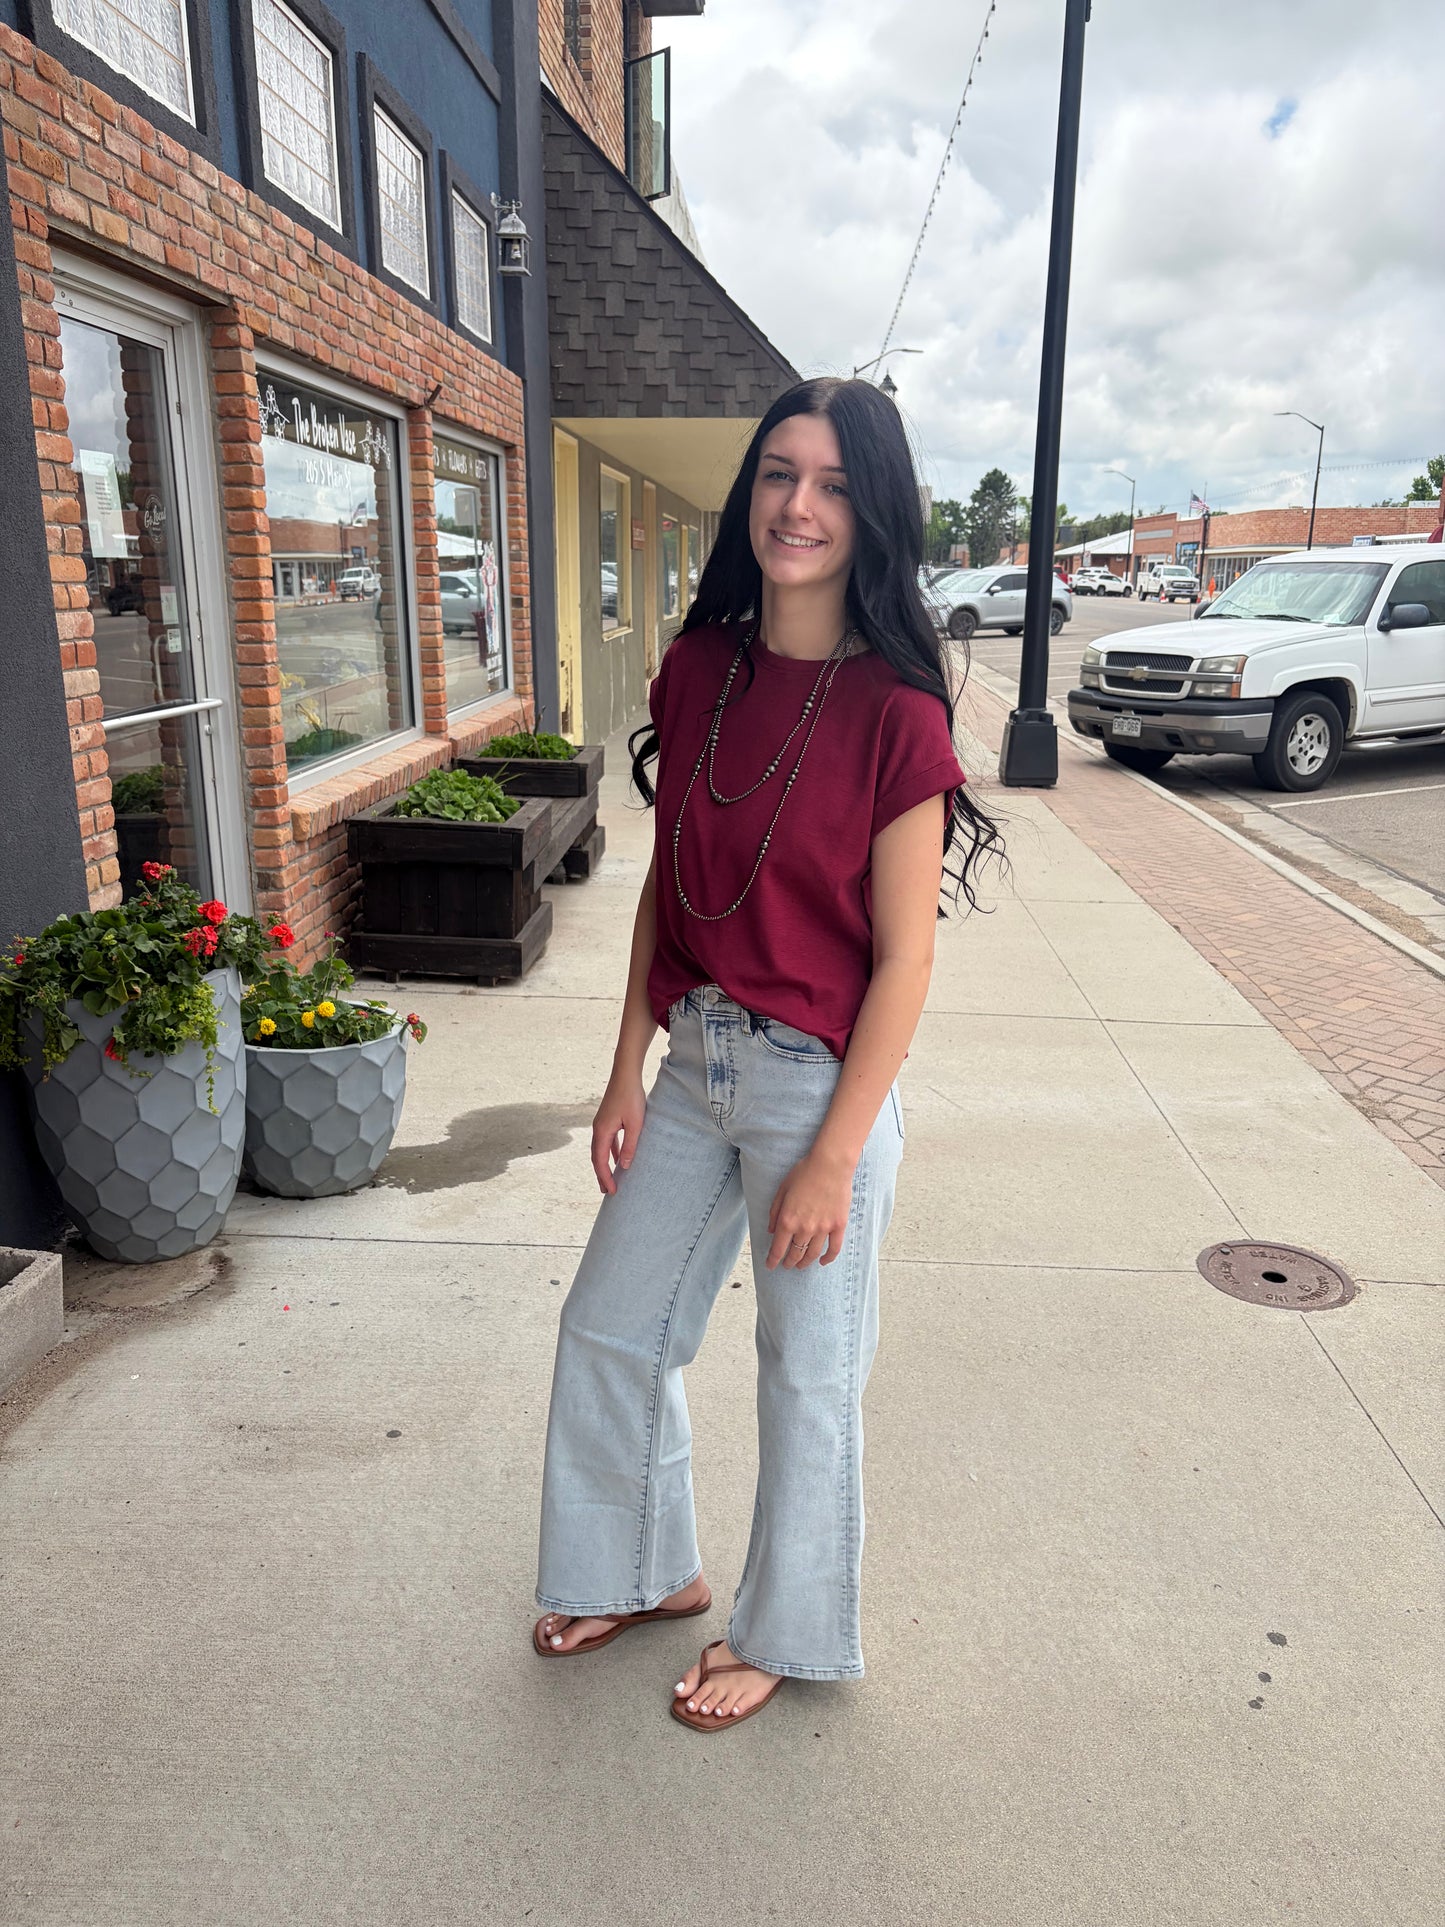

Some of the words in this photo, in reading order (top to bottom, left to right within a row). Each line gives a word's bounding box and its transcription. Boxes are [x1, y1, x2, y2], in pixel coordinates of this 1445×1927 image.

[291, 397, 310, 444] The
[310, 402, 339, 454] Broken
[338, 412, 357, 455] Vase
[319, 458, 326, 485] S
[1249, 1251, 1298, 1265] WATER
